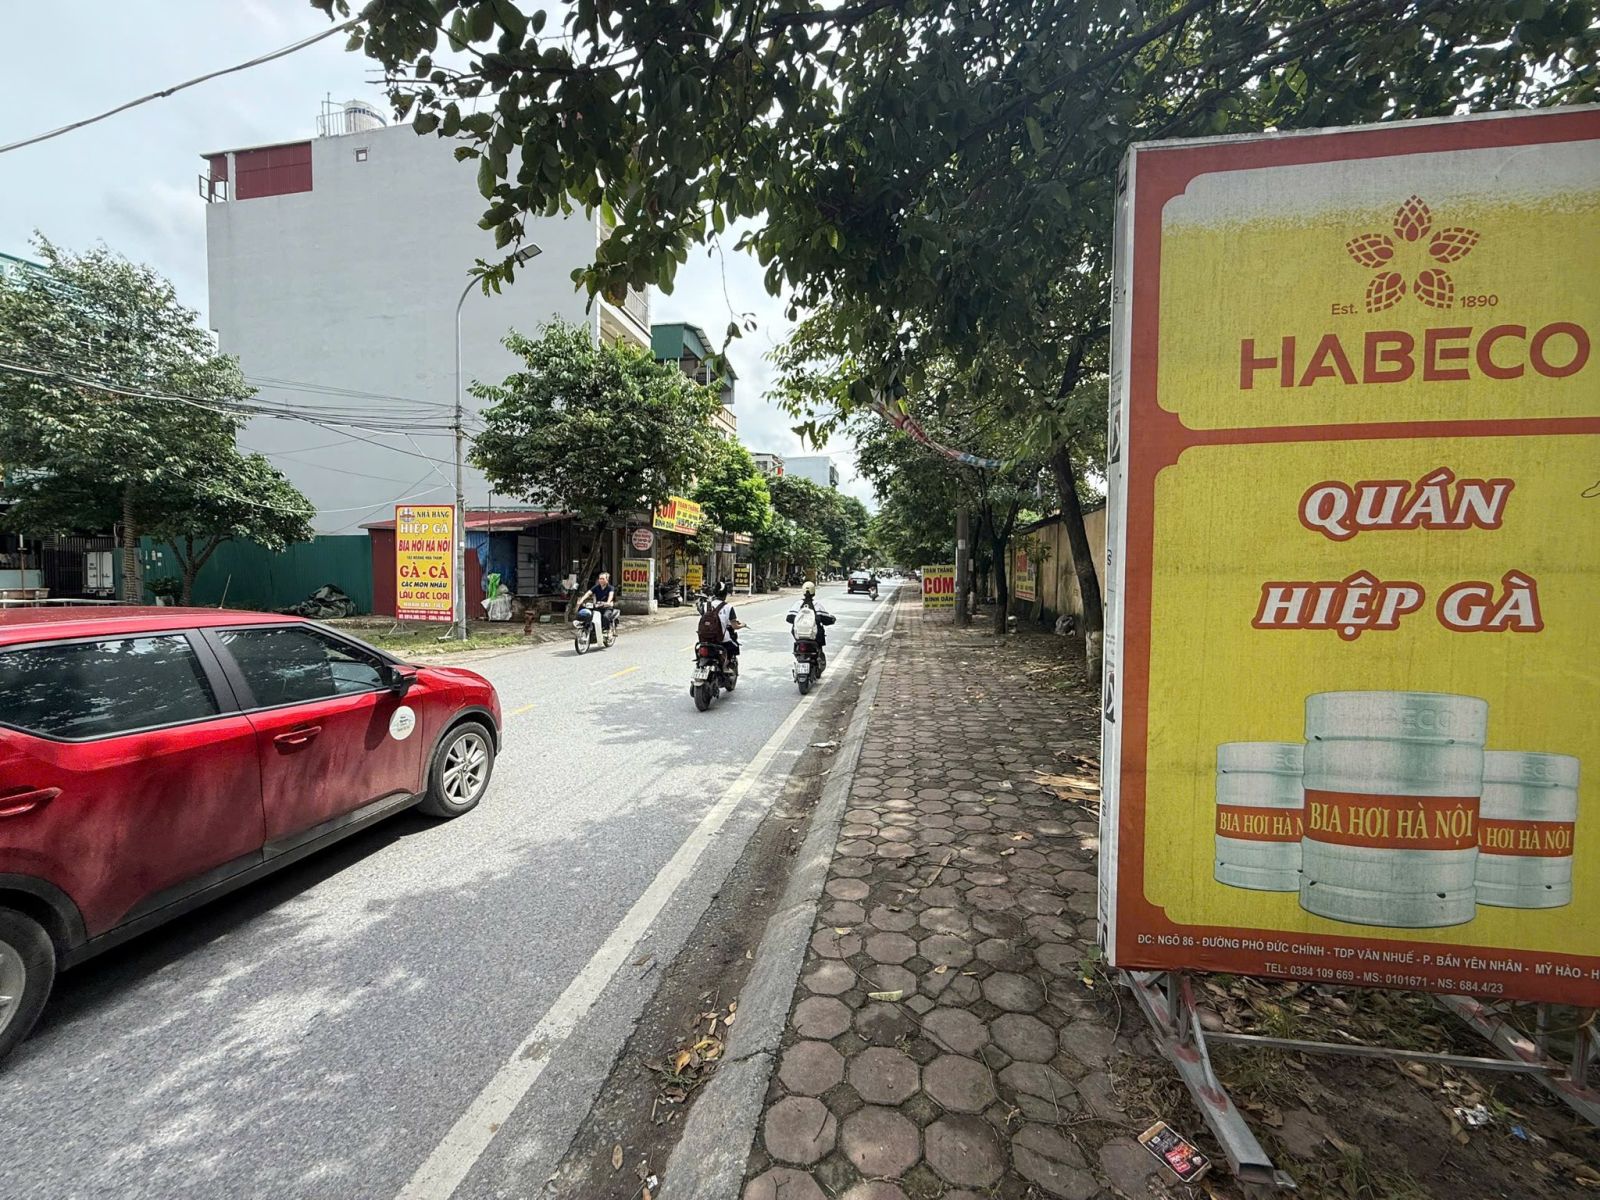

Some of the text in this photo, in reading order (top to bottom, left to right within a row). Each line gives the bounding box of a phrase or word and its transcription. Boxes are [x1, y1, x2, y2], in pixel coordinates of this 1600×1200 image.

[1331, 294, 1499, 315] Est. 1890
[1240, 322, 1590, 390] HABECO
[1301, 470, 1512, 538] QUÁN
[400, 521, 429, 536] HIỆP
[399, 539, 410, 552] BIA
[399, 561, 420, 578] GÀ
[428, 561, 449, 579] CÁ
[623, 568, 648, 582] CƠM
[923, 574, 955, 594] CƠM
[1254, 572, 1542, 638] HIỆP GÀ
[1220, 812, 1240, 832] BIA
[1243, 814, 1270, 835] HƠI
[1271, 810, 1293, 836] HÀ
[1309, 801, 1342, 833] BIA
[1348, 805, 1390, 839] HƠI
[1396, 801, 1430, 839] HÀ
[1434, 803, 1475, 846] NỘI
[1486, 827, 1515, 849] HƠI
[1518, 824, 1541, 850] HÀ
[1545, 825, 1571, 854] NỘI
[1137, 934, 1155, 944] ĐC:
[1182, 936, 1194, 946] 86
[1201, 935, 1240, 949] ĐƯỜNG
[1266, 940, 1289, 953] ĐỨC
[1291, 942, 1325, 957] CHÍNH
[1333, 947, 1355, 959] TDP
[1382, 949, 1415, 964] NHUẾ
[1422, 954, 1434, 965] P.
[1463, 956, 1487, 970] YÊN
[1489, 958, 1523, 973] NHÂN
[1535, 961, 1553, 975] MỸ
[1555, 963, 1582, 978] HÀO
[1264, 962, 1287, 975] TEL:
[1290, 965, 1314, 977] 0384
[1316, 967, 1334, 978] 109
[1335, 969, 1354, 981] 669
[1363, 971, 1383, 983] MS:
[1385, 973, 1428, 987] 0101671
[1437, 978, 1457, 990] NS:
[1459, 980, 1504, 994] 684.4/23
